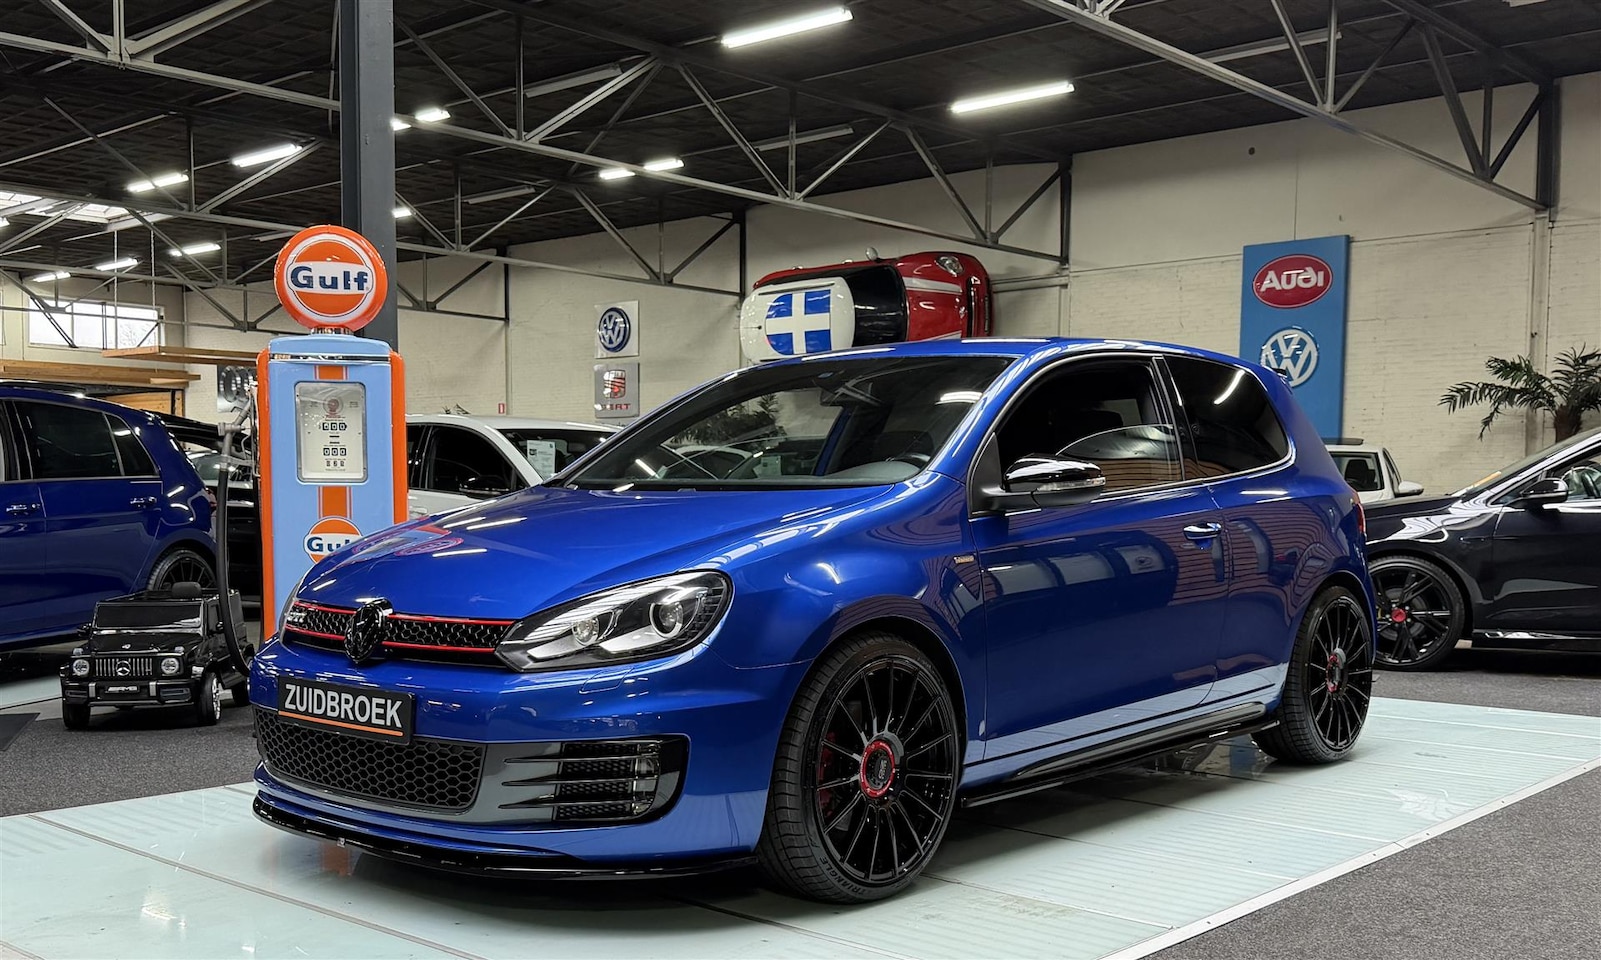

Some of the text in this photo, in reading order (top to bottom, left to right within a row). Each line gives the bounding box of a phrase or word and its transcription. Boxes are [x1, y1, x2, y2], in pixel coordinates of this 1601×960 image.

[290, 266, 368, 290] Gulf
[284, 684, 402, 728] ZUIDBROEK
[820, 857, 866, 895] TRIANGLE
